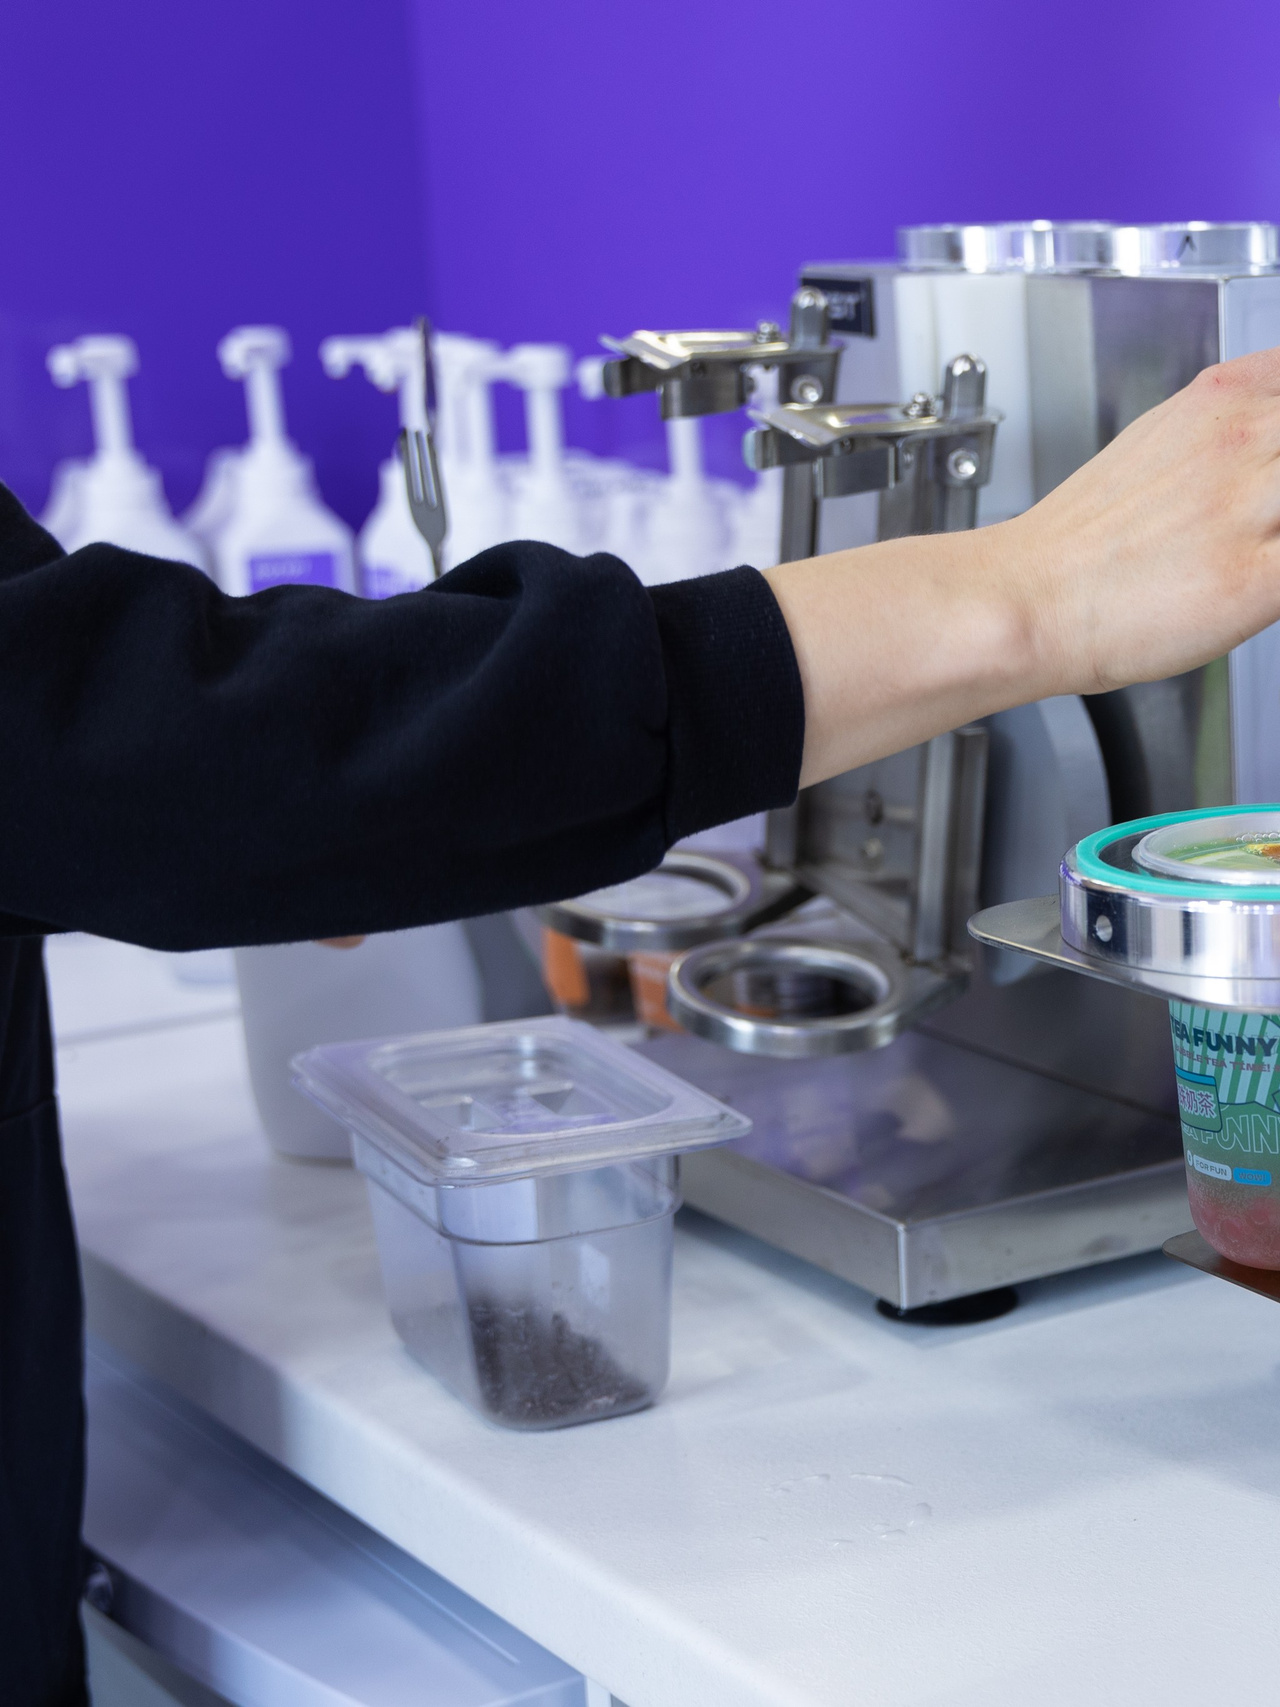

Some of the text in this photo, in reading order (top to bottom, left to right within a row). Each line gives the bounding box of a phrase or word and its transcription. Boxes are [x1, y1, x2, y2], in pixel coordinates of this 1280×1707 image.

[1193, 1025, 1279, 1057] FUNNY
[1205, 1056, 1227, 1069] TEA
[1195, 1161, 1227, 1177] FOR FUN
[1239, 1172, 1266, 1181] WOW!
